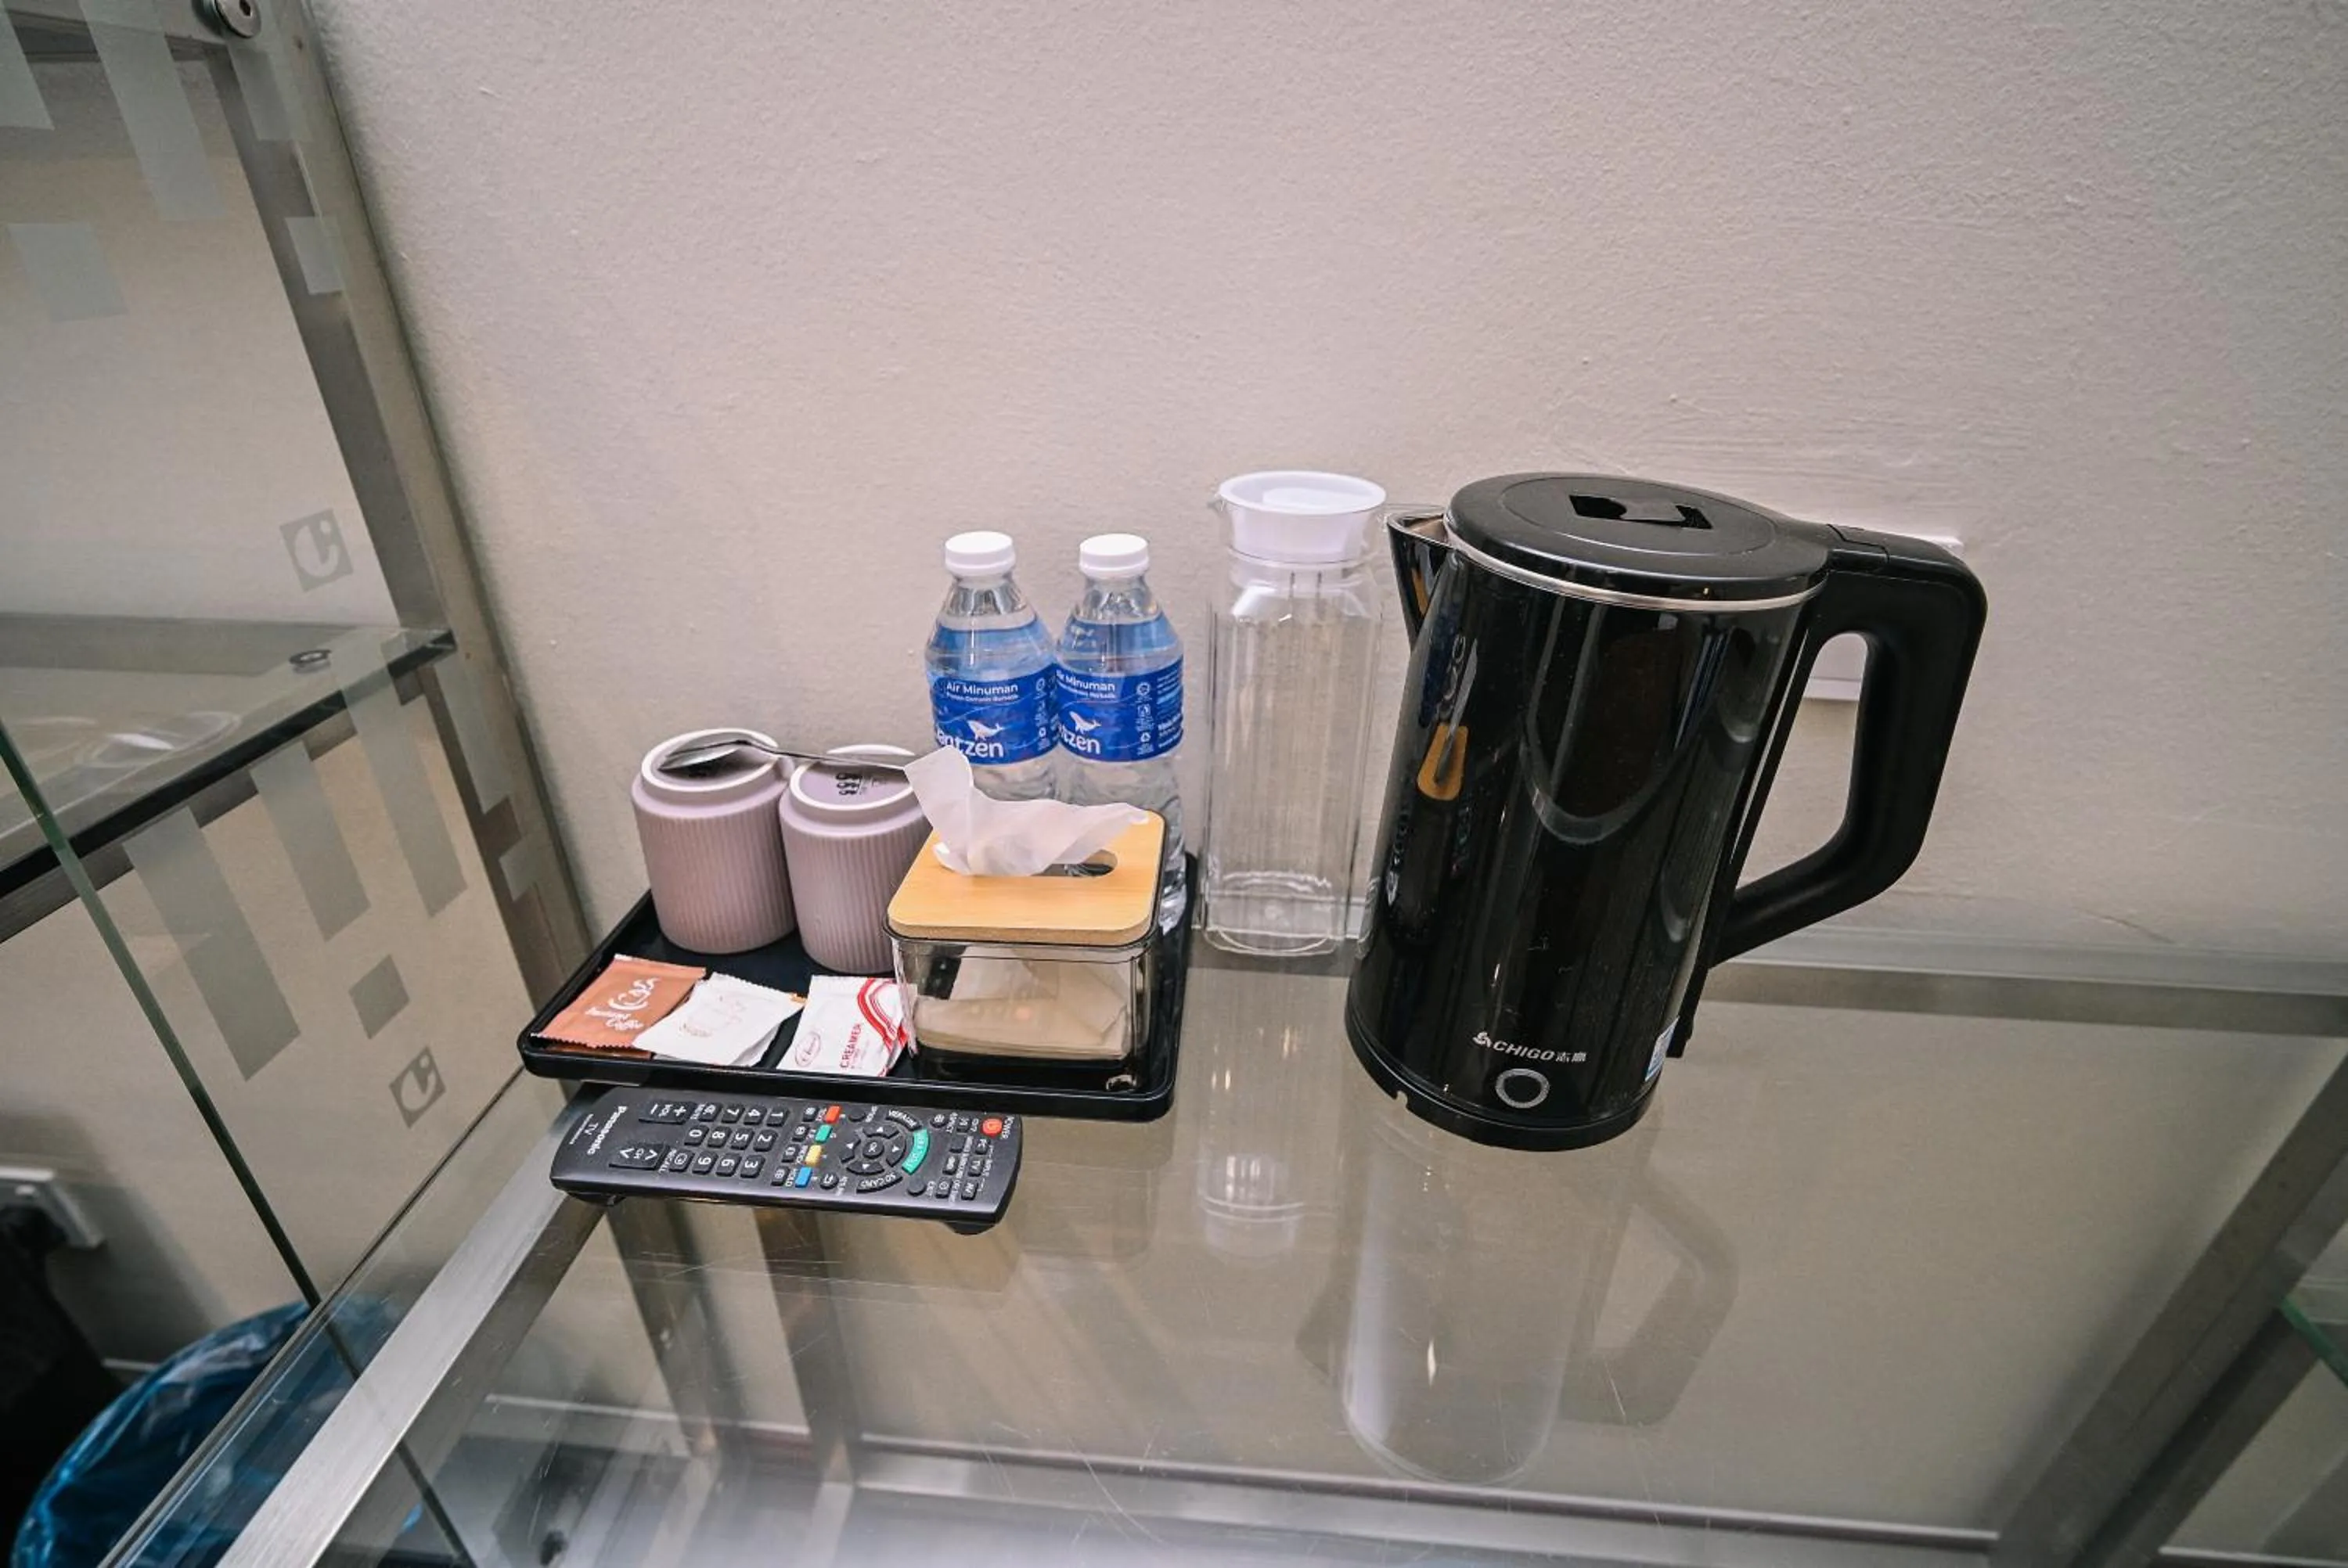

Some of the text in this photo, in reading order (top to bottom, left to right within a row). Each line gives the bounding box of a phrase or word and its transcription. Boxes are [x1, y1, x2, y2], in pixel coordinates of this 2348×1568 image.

[1065, 674, 1115, 692] Minuman
[946, 682, 1018, 696] Air Minuman
[1493, 1040, 1555, 1061] CHIGO
[727, 1108, 740, 1117] 7
[747, 1109, 761, 1117] 4
[689, 1129, 702, 1138] 0
[711, 1131, 725, 1140] 8
[735, 1132, 749, 1142] 5
[758, 1134, 772, 1142] 2
[698, 1156, 711, 1166] 9
[721, 1158, 734, 1167] 6
[744, 1160, 758, 1169] 3
